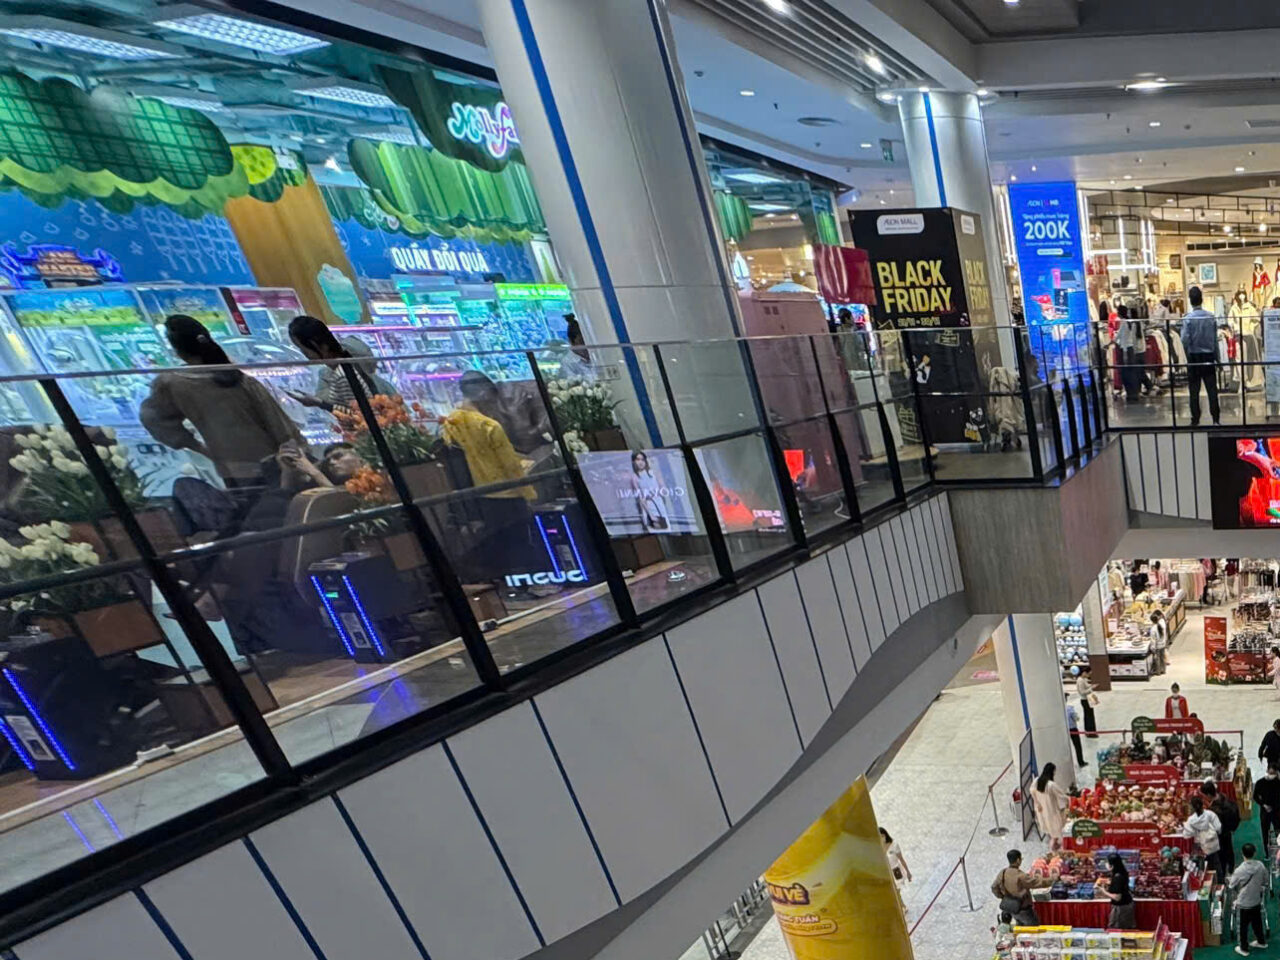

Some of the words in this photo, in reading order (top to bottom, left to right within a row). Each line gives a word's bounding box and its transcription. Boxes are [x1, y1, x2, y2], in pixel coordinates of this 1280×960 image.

[1023, 220, 1072, 240] 200K
[877, 259, 947, 288] BLACK
[882, 286, 952, 313] FRIDAY
